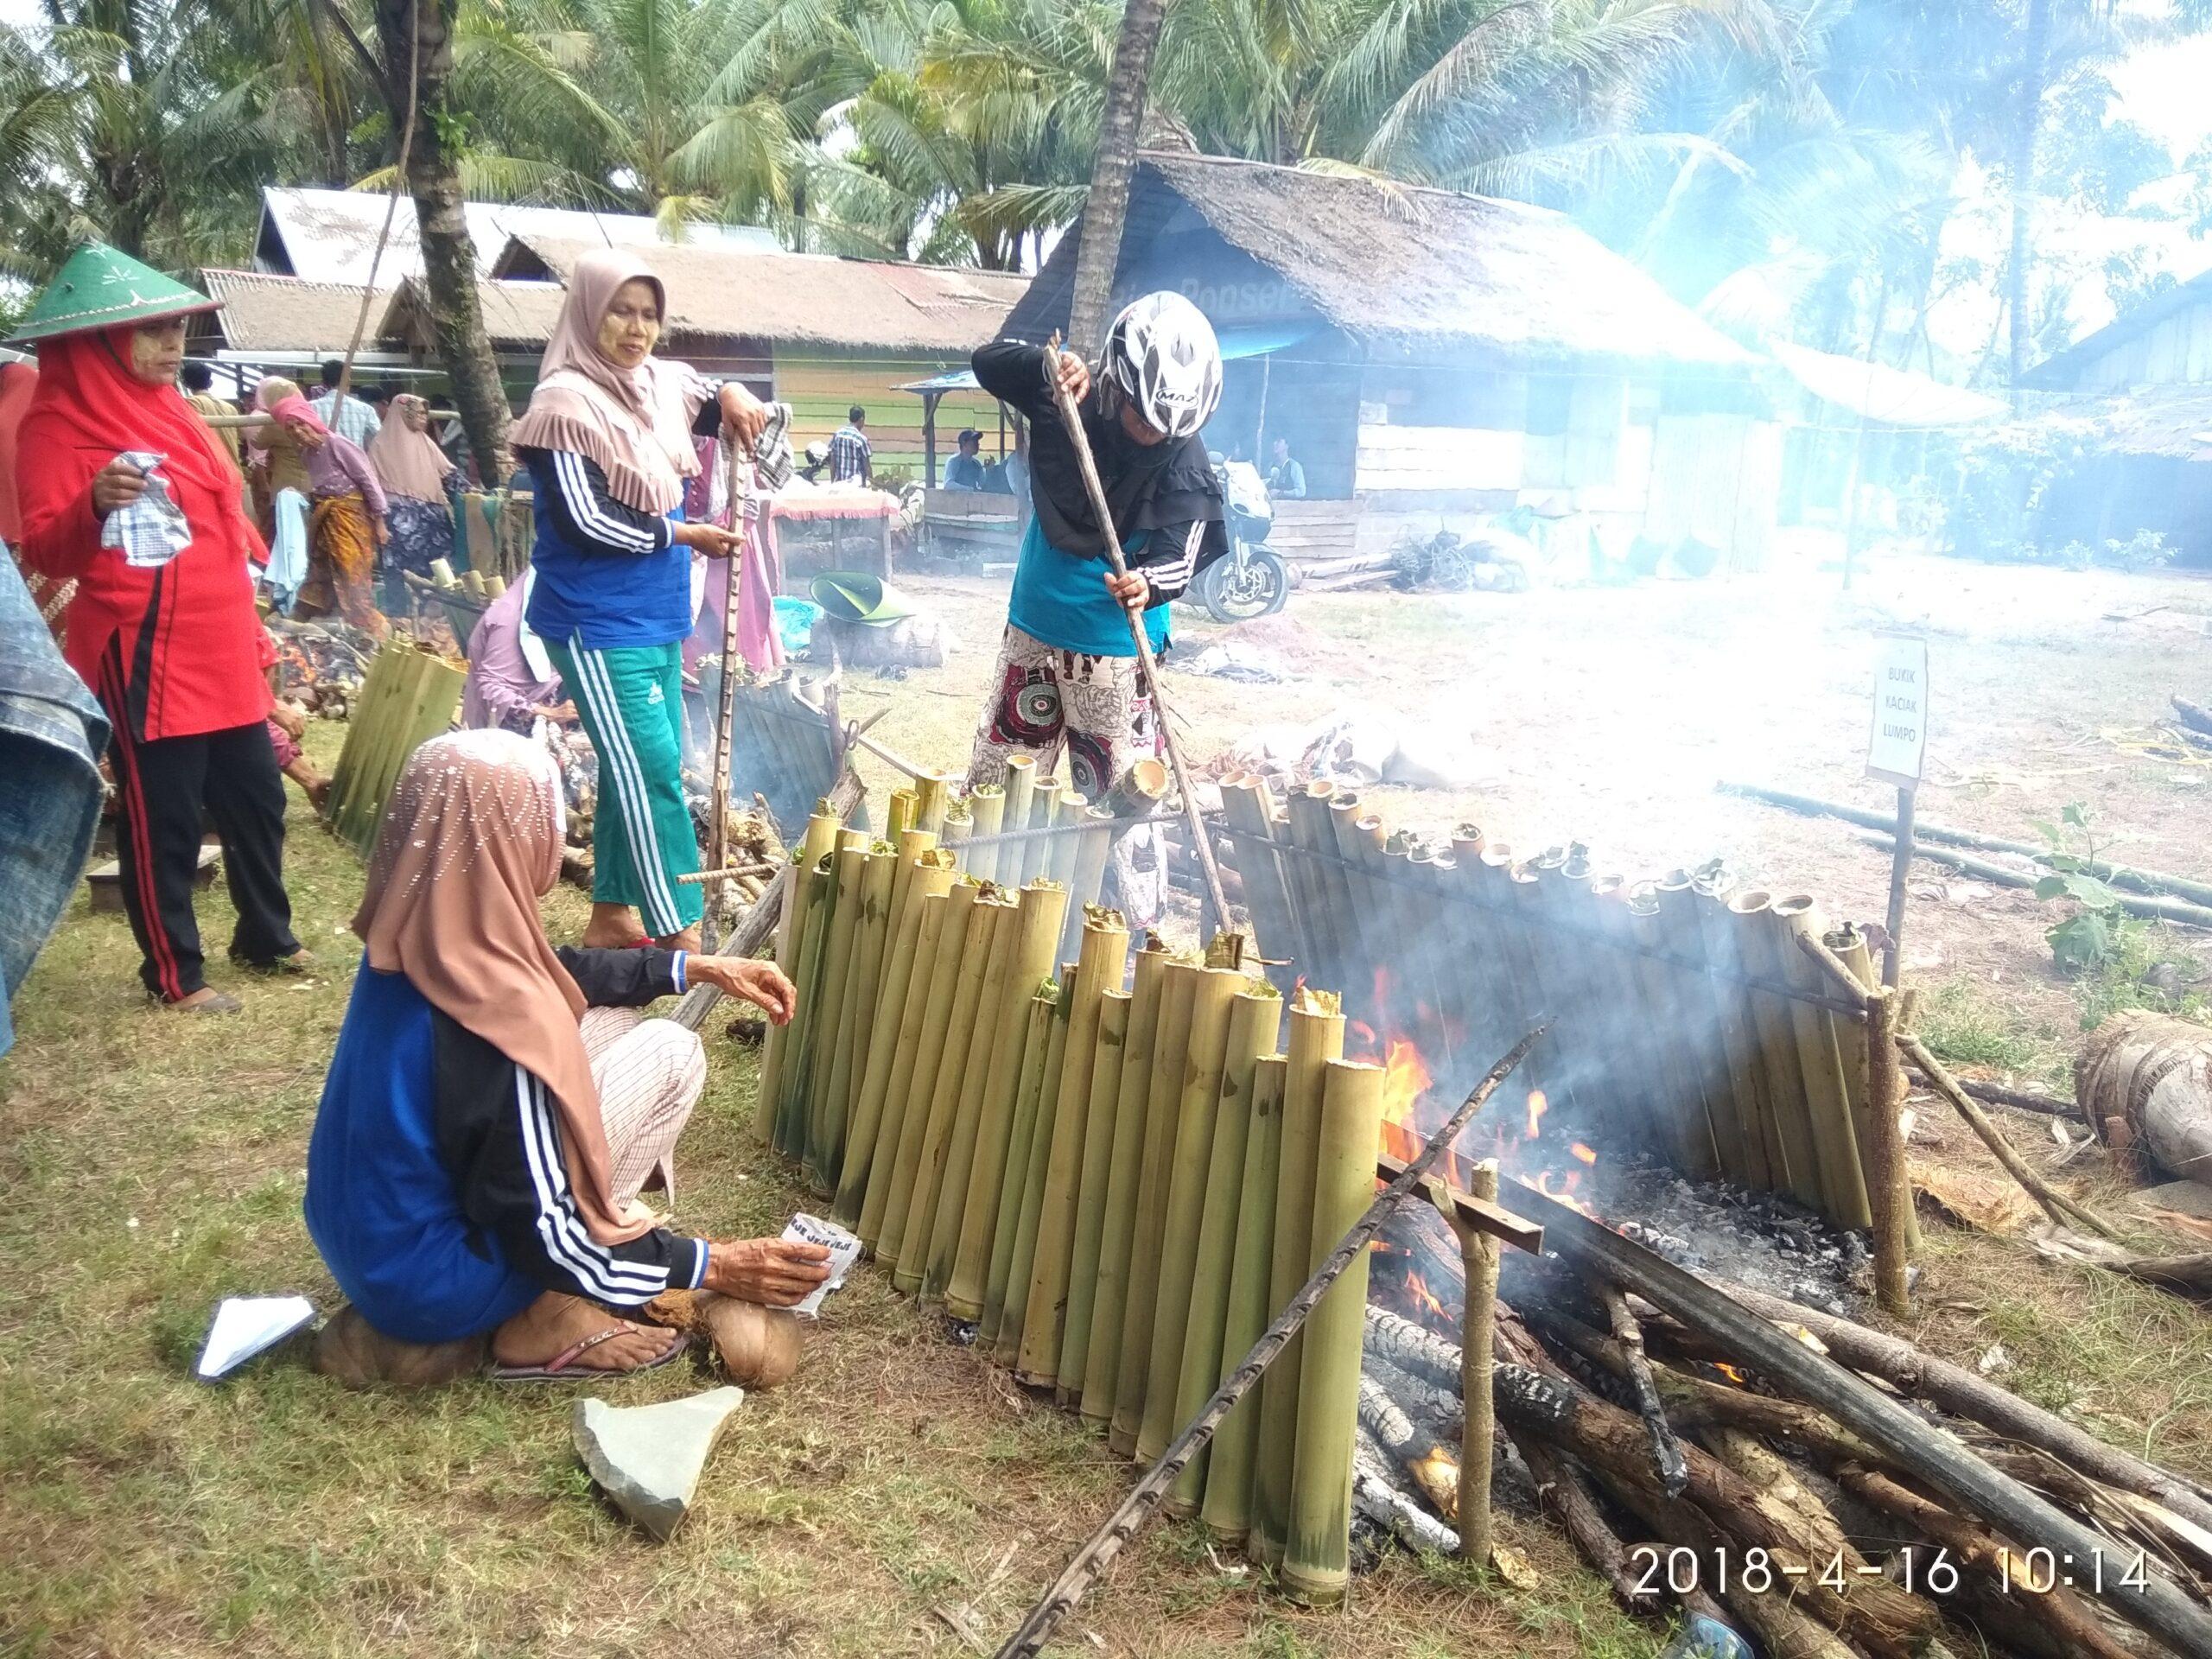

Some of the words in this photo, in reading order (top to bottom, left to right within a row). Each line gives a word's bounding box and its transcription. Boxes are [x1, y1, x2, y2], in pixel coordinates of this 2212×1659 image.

[1889, 667, 1915, 683] BUKIK
[1885, 696, 1916, 713] KACIAK
[1883, 724, 1916, 742] LUMPO
